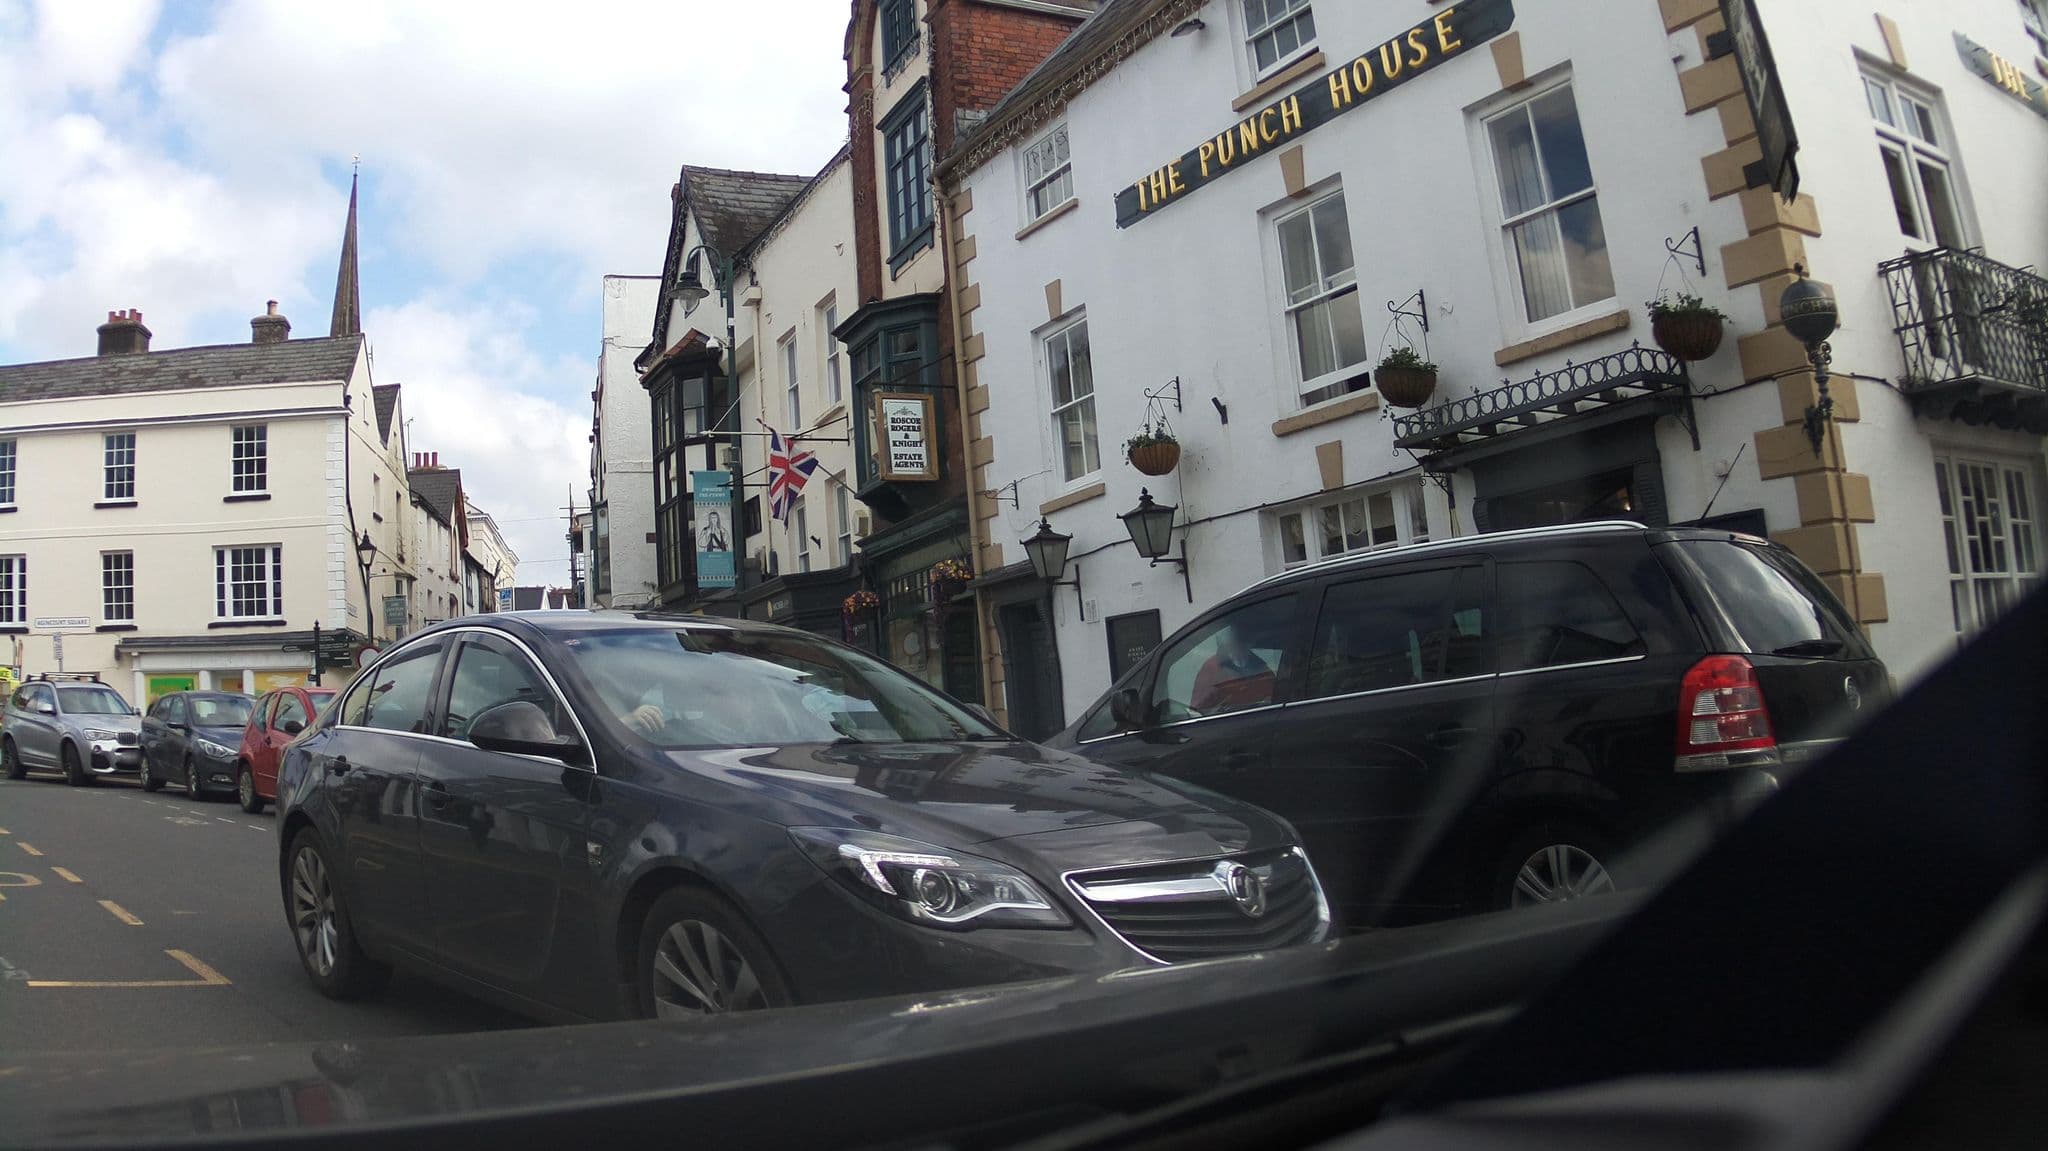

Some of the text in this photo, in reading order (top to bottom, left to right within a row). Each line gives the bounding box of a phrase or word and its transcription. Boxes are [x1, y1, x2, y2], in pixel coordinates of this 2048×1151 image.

[1988, 50, 2033, 102] THE
[1135, 8, 1462, 212] THE PUNCH HOUSE
[891, 416, 922, 425] ROSCOE
[891, 424, 922, 432] ROGERS
[903, 432, 910, 440] &
[892, 440, 924, 448] KNIGHT
[893, 453, 923, 461] ESTATE
[895, 461, 925, 469] AGENTS
[67, 618, 88, 626] SQUARE
